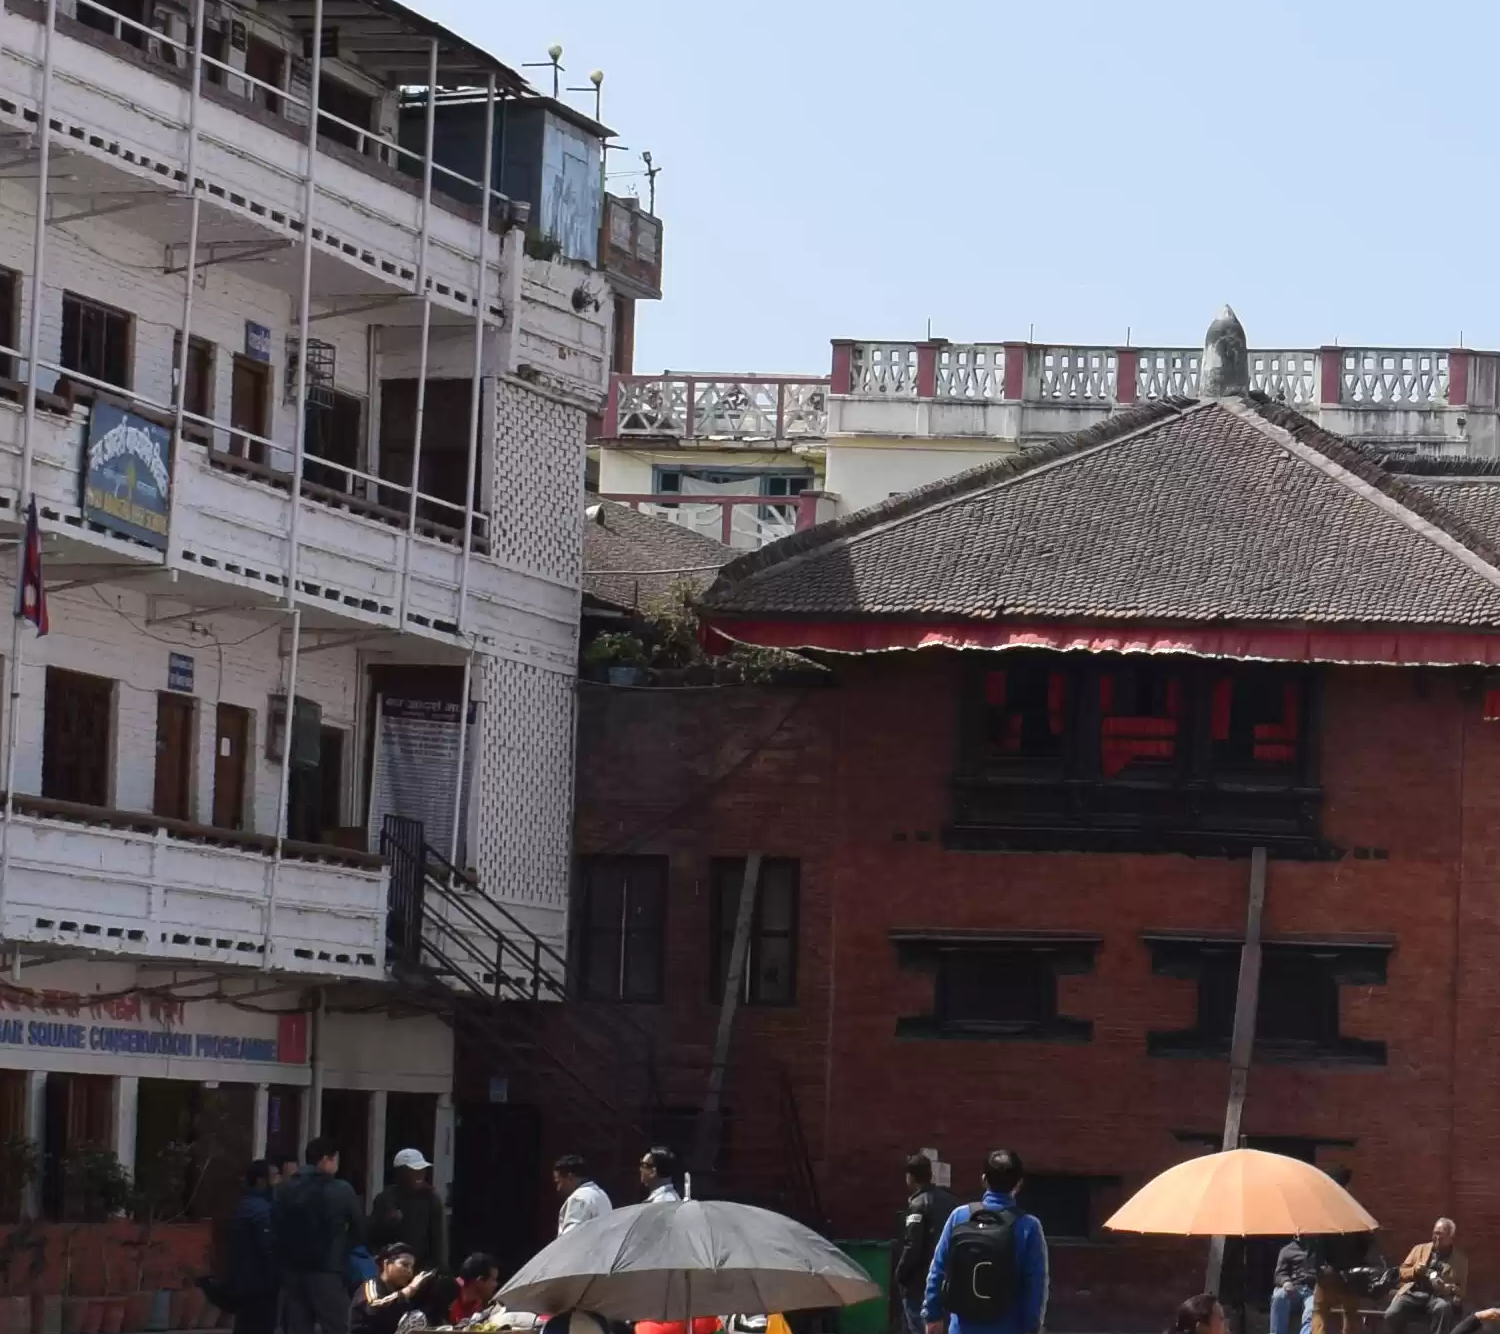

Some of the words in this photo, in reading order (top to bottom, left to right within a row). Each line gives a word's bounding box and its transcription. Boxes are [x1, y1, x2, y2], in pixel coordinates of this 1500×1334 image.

[28, 1021, 87, 1049] SQUARE
[89, 1026, 193, 1057] CONSERVATION
[195, 1033, 277, 1062] PROGRAMME
